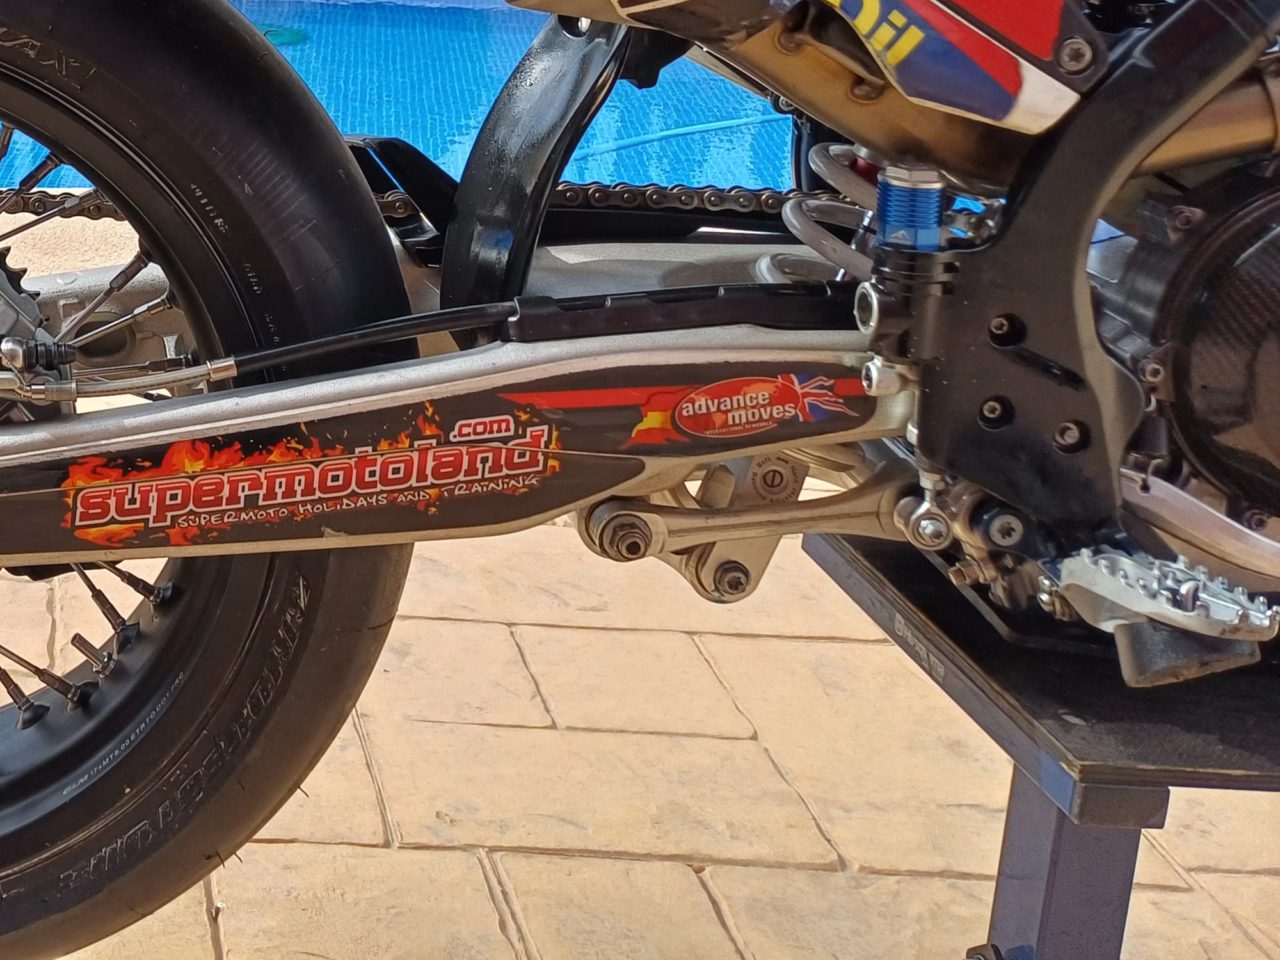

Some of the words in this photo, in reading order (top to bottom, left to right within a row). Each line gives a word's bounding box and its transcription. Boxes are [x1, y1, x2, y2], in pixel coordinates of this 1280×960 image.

[680, 390, 770, 418] advance
[727, 402, 796, 426] moves
[449, 414, 513, 442] .com
[74, 424, 550, 528] supermotoland
[177, 505, 288, 528] SUPERMOTO
[397, 490, 430, 503] AND
